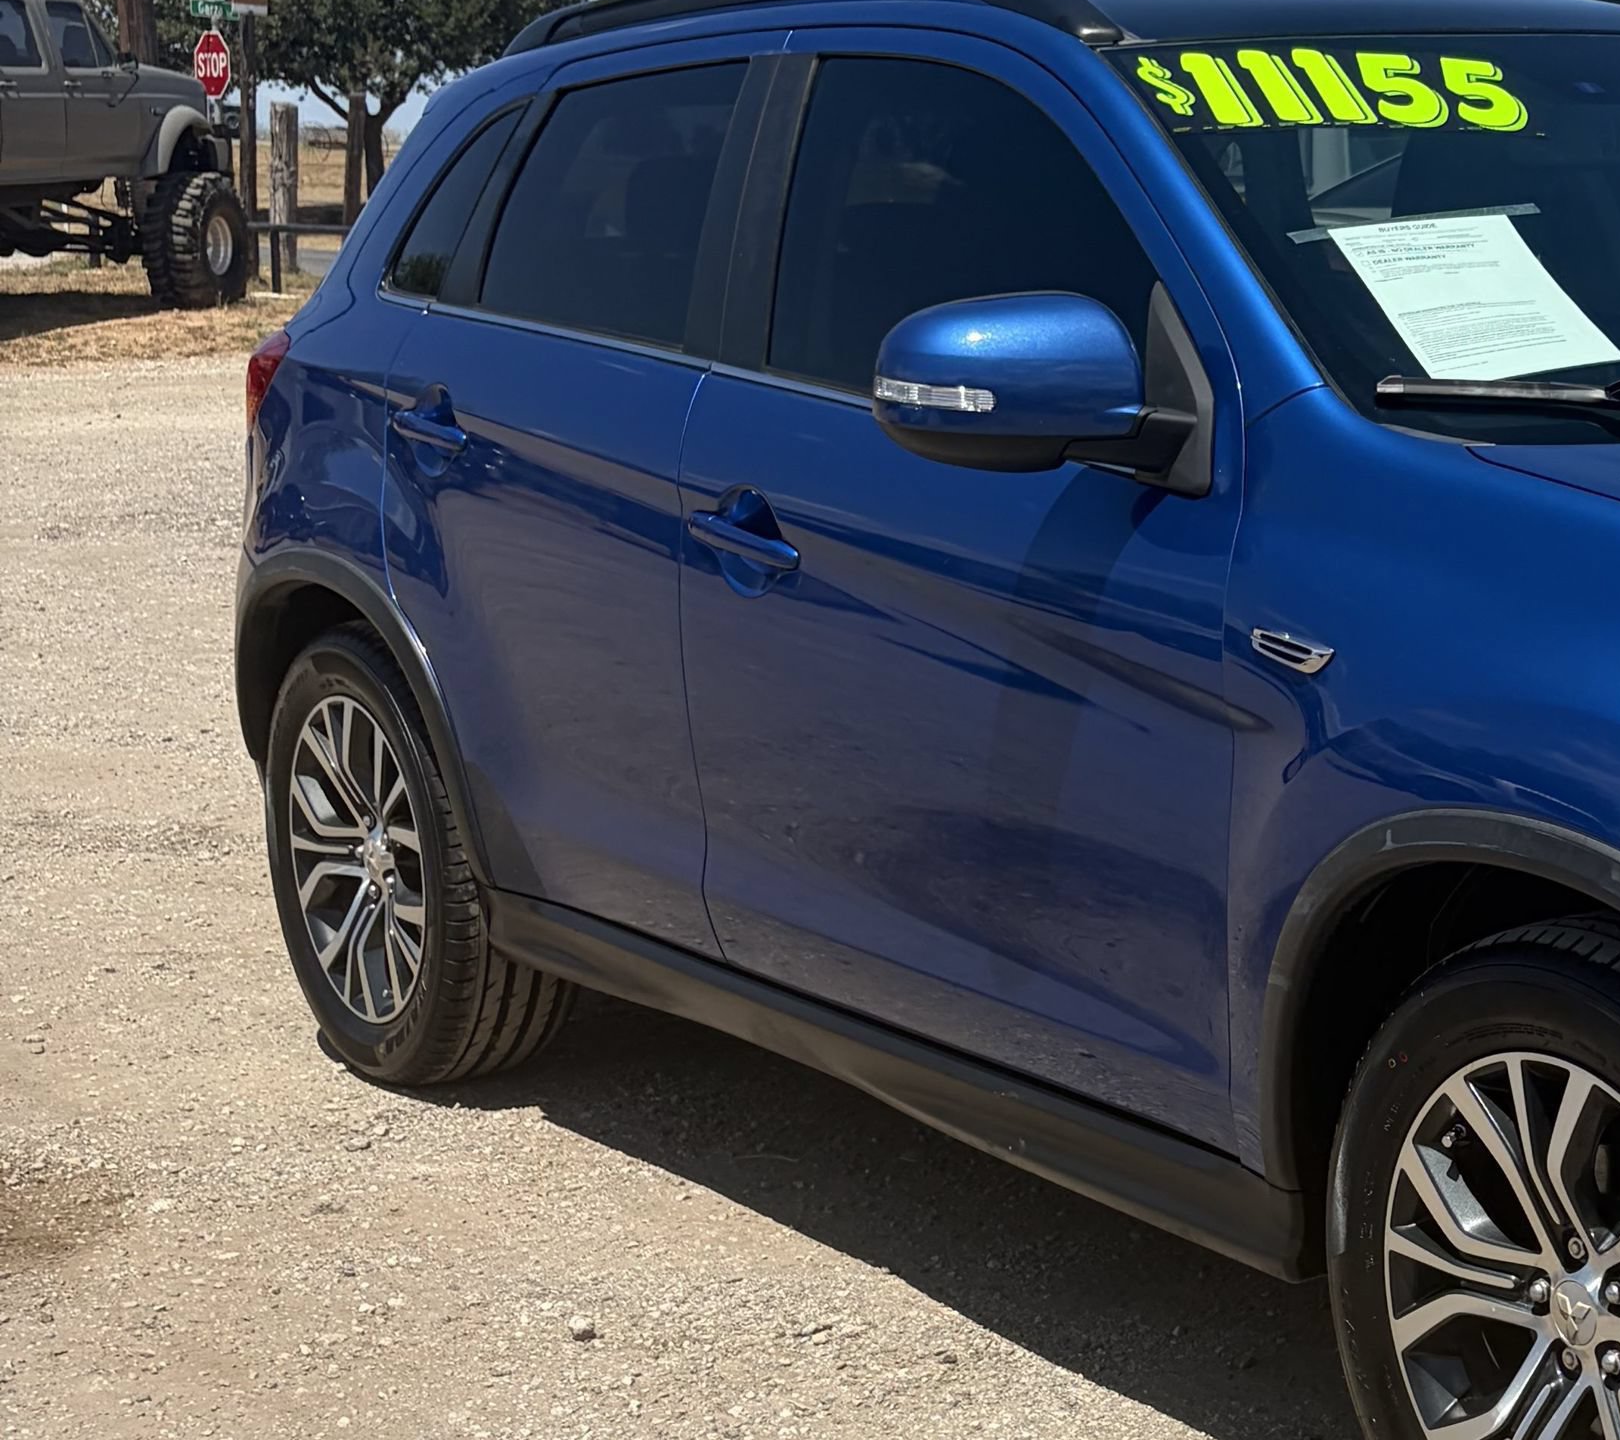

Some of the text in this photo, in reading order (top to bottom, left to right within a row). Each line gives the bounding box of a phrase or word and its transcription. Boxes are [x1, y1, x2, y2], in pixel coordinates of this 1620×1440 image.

[197, 51, 227, 79] STOP
[1136, 48, 1529, 132] $11155
[1378, 222, 1438, 233] BUYERS GUIDE
